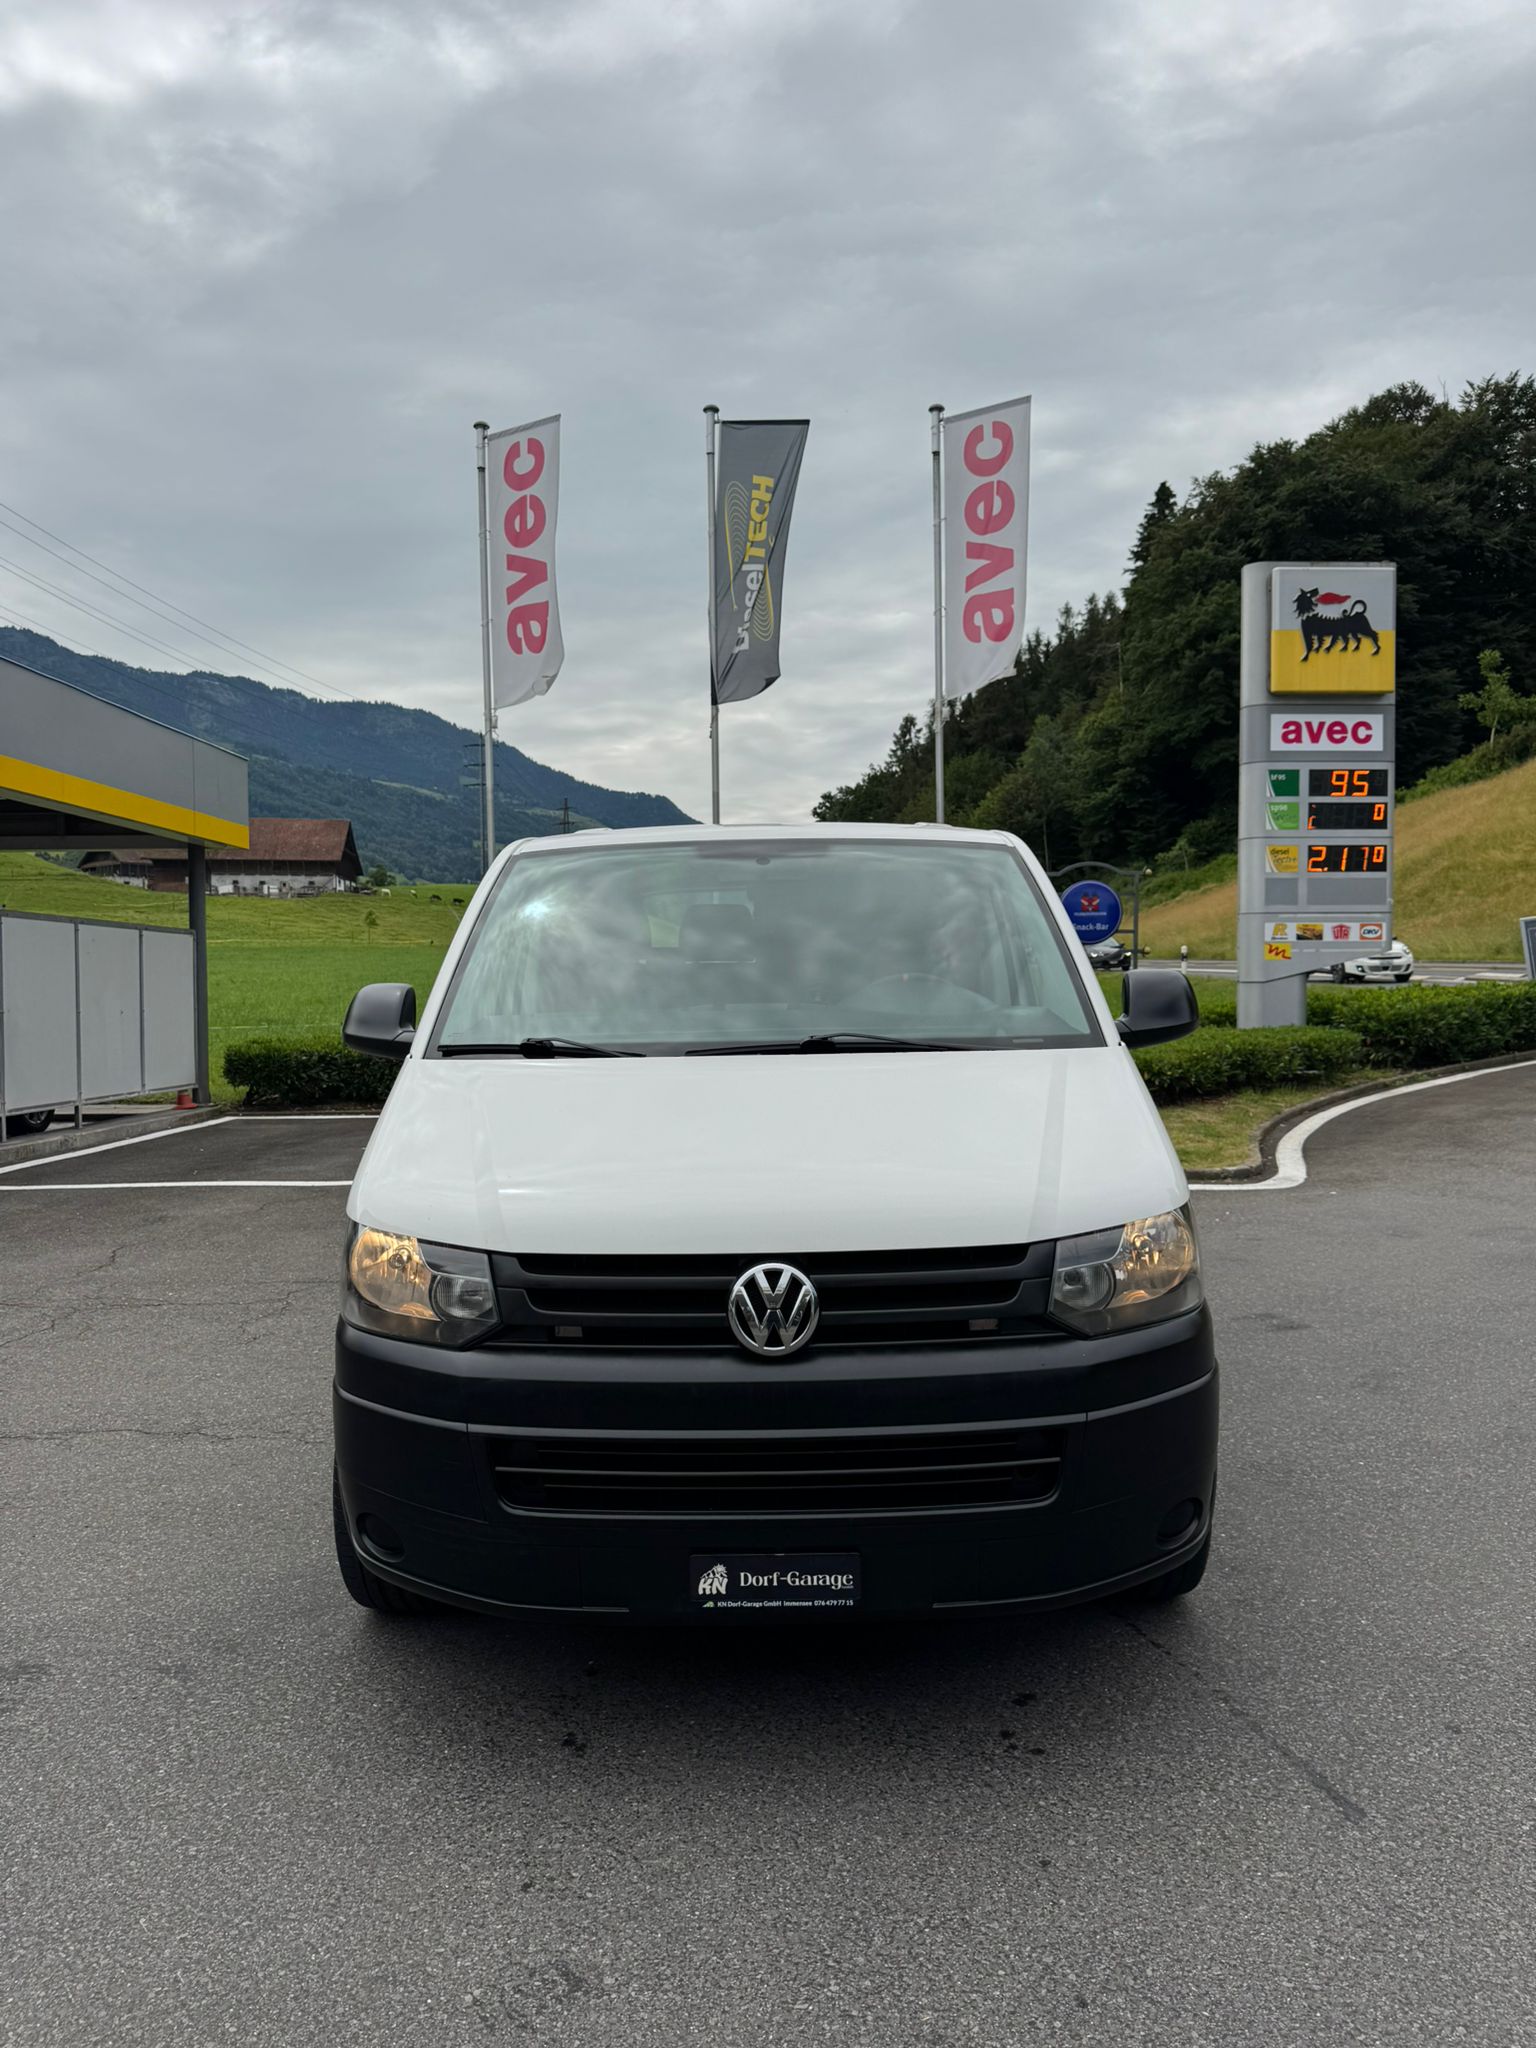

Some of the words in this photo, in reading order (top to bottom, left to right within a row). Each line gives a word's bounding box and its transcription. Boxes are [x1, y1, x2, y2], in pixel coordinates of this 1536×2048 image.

[503, 437, 550, 656] avec
[962, 420, 1016, 644] avec
[1280, 720, 1373, 745] avec
[739, 1571, 854, 1590] Dorf-Garage
